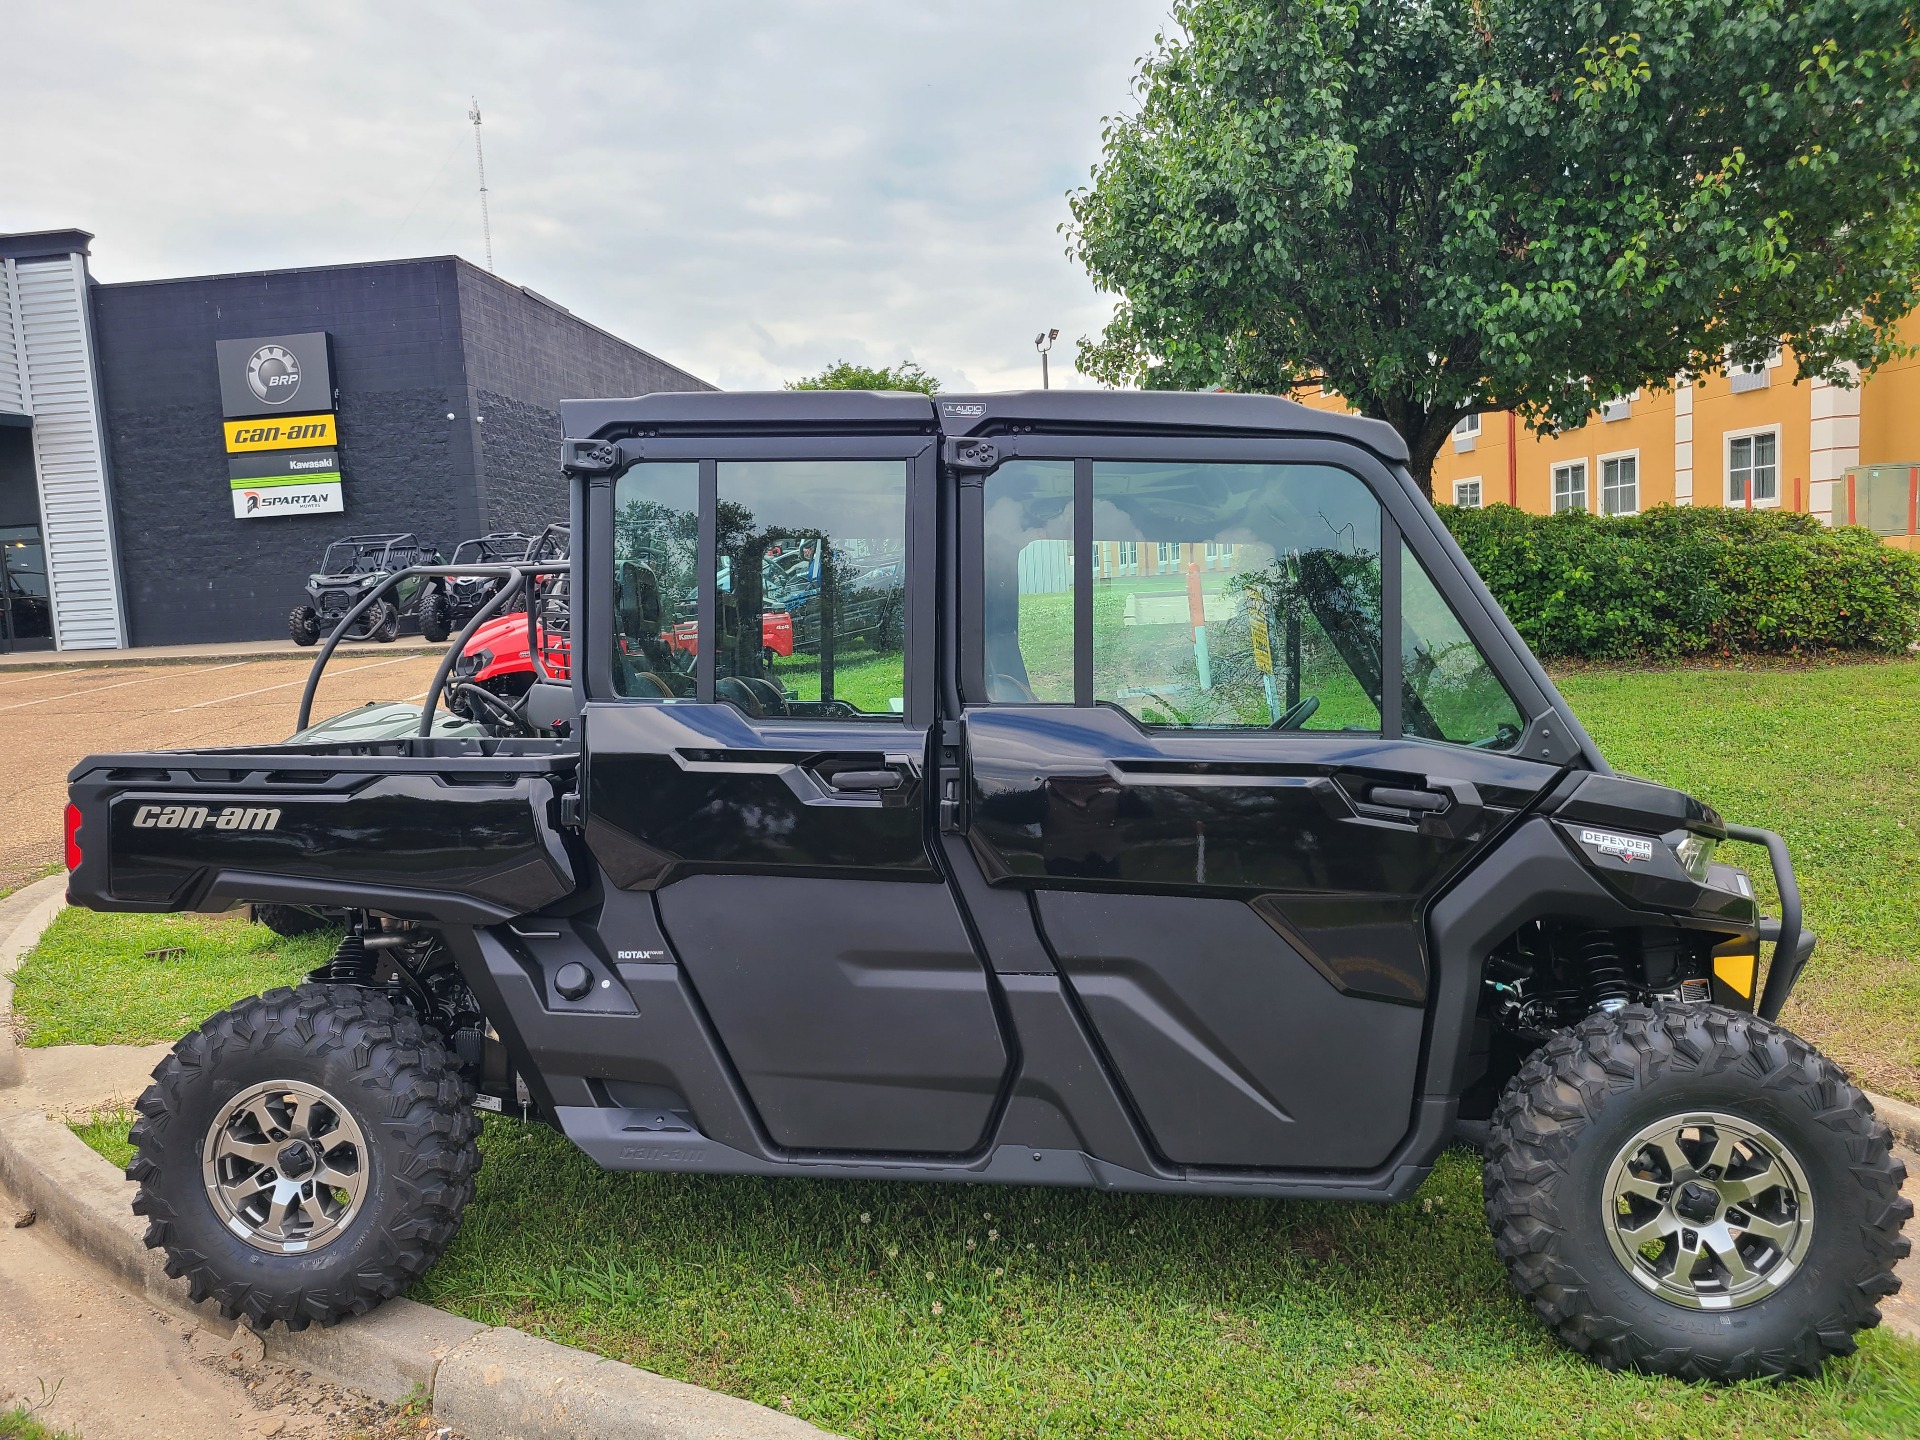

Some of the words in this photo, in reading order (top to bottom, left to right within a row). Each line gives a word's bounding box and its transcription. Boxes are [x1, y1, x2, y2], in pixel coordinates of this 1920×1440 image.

[269, 374, 299, 387] BRP
[234, 423, 327, 444] can-am
[290, 459, 332, 470] Kawasaki
[261, 494, 328, 507] SPARTAN
[678, 633, 698, 641] Kawa
[132, 806, 281, 831] can-am
[1585, 832, 1651, 851] DEFENDER
[617, 951, 650, 959] ROTAX
